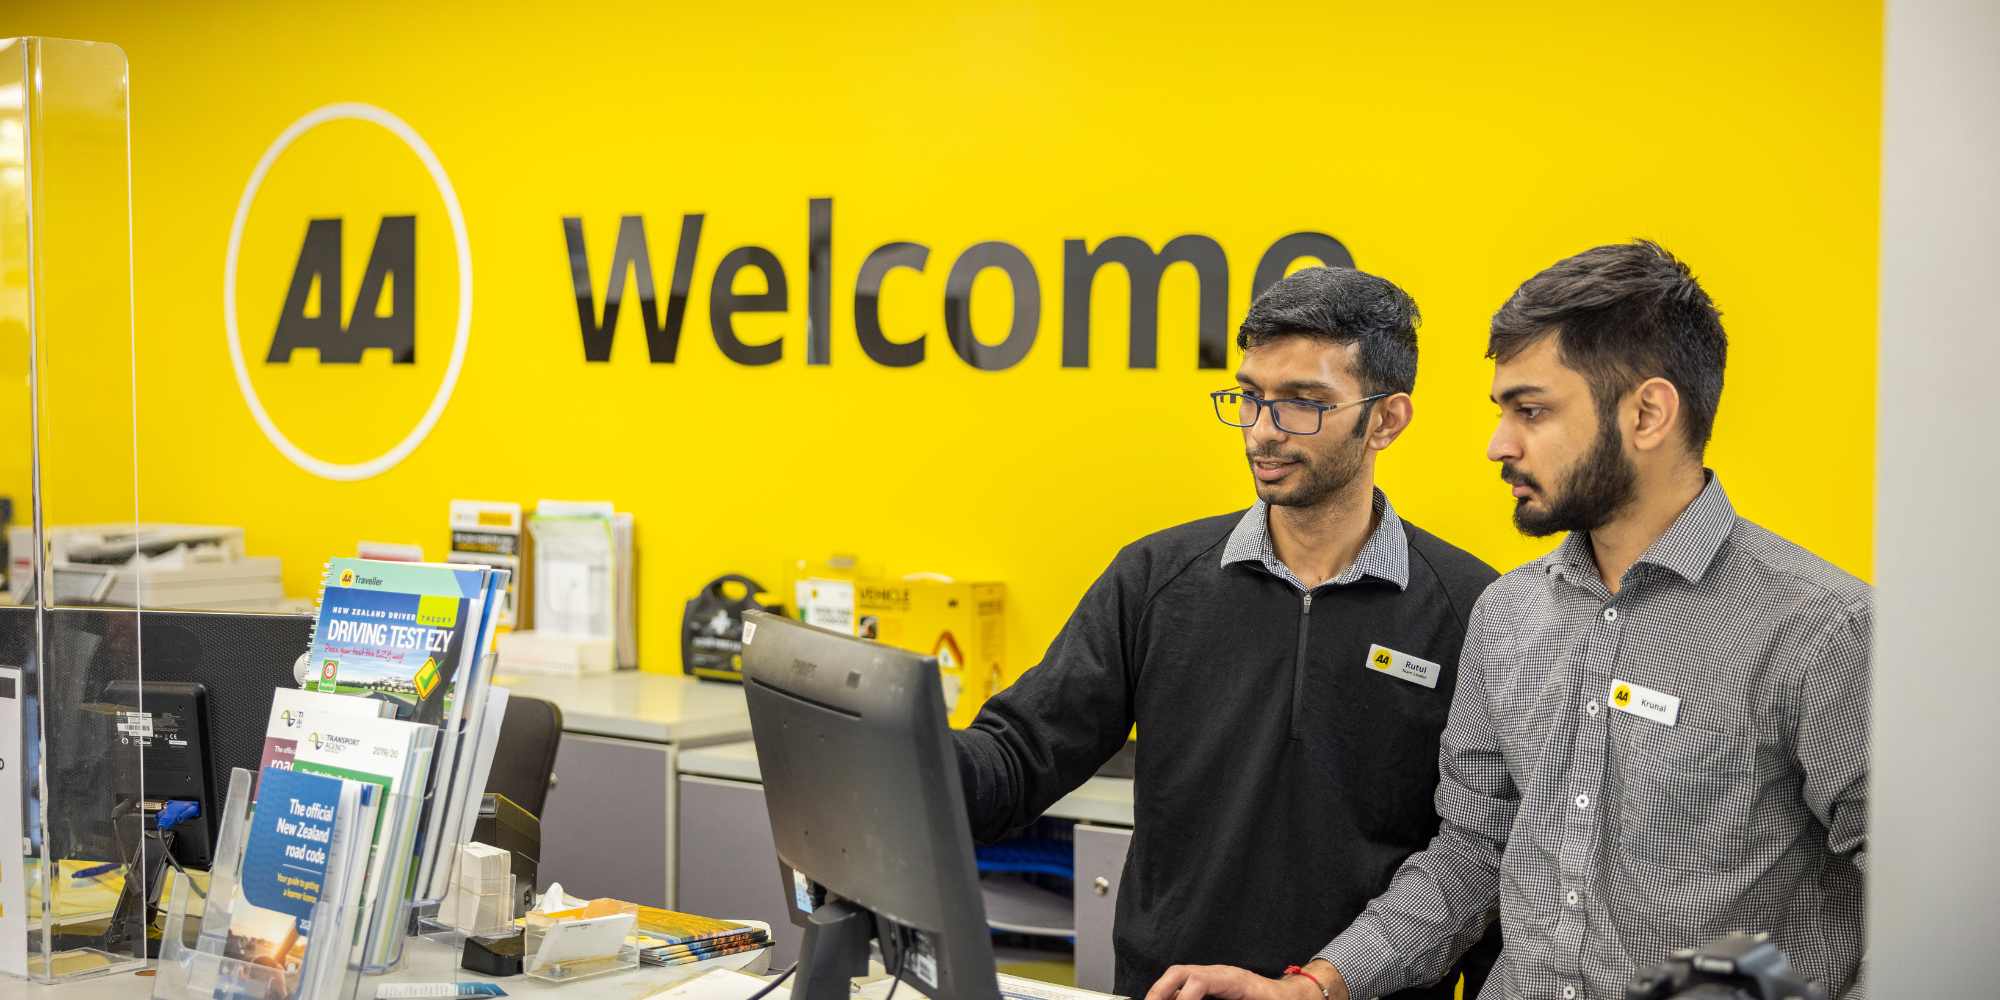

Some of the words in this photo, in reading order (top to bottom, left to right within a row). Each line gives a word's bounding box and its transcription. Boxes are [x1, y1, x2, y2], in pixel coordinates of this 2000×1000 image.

[264, 214, 417, 364] AA
[355, 575, 384, 586] Traveller
[332, 606, 350, 615] NEW
[351, 608, 386, 618] ZEALAND
[328, 620, 387, 645] DRIVING
[390, 625, 425, 650] TEST
[425, 629, 454, 652] EZY
[1406, 661, 1426, 674] Rutul
[1641, 699, 1667, 713] Krunal
[327, 734, 361, 746] TRANSPORT
[290, 798, 306, 817] The
[305, 802, 335, 822] official
[276, 817, 298, 837] New
[296, 821, 331, 844] Zealand
[285, 844, 306, 860] road
[305, 848, 326, 865] code
